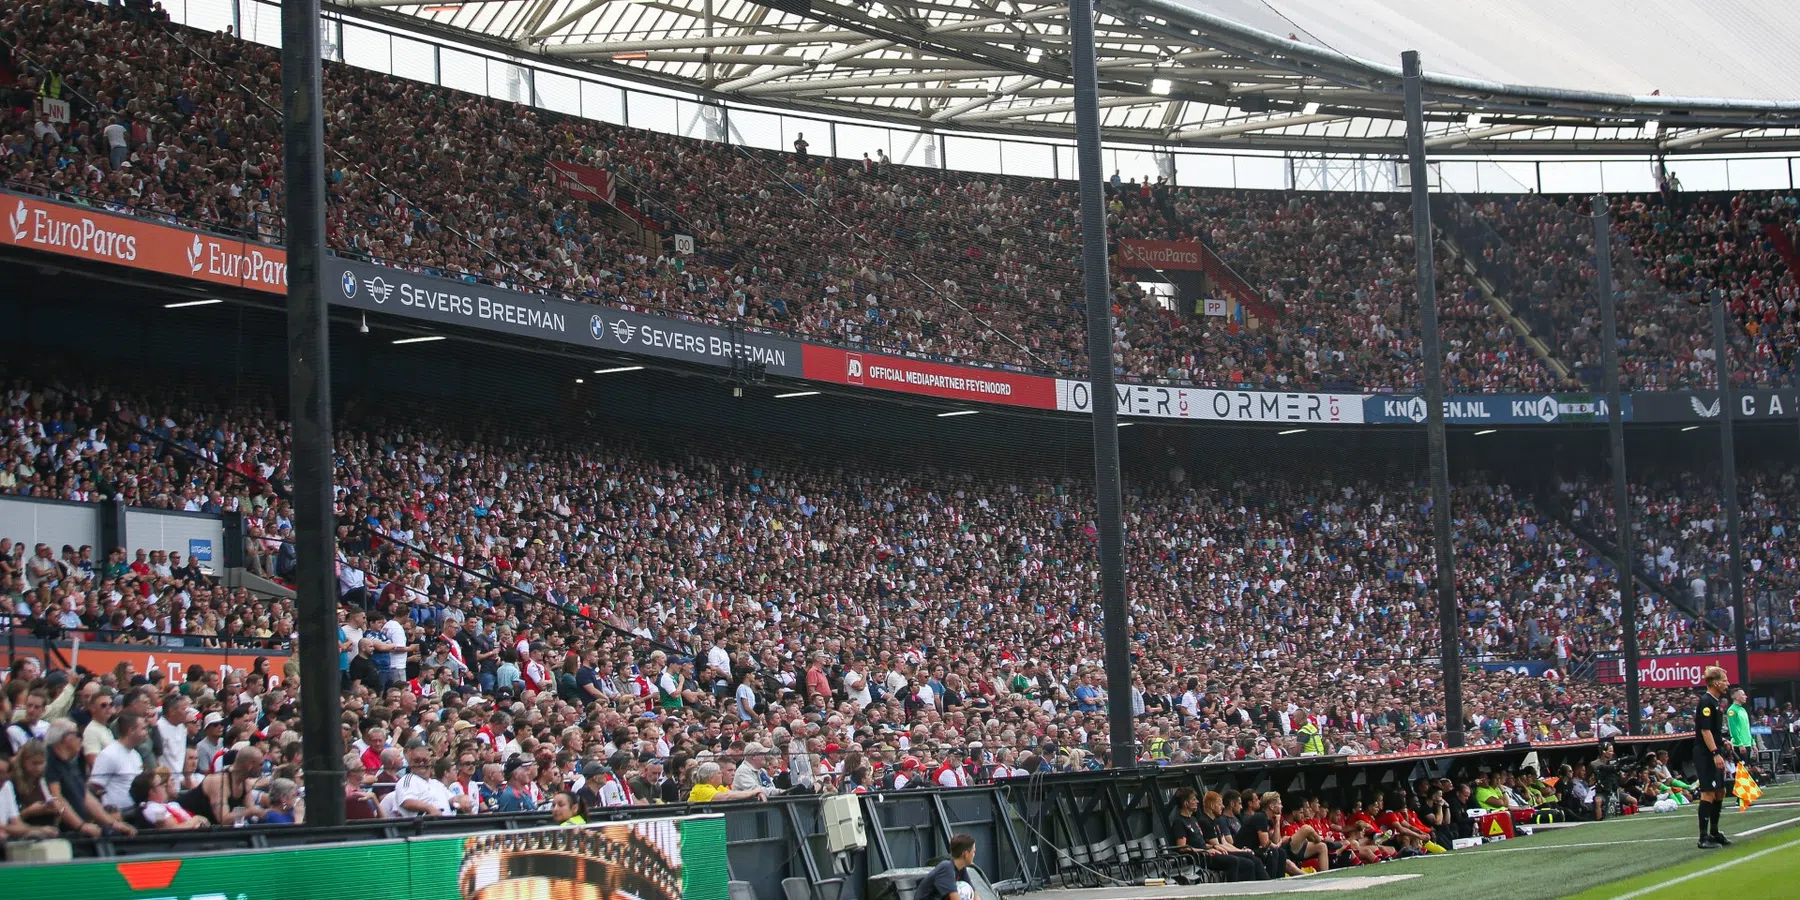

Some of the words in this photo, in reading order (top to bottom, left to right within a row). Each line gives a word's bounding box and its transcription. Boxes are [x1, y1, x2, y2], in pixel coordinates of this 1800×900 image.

[49, 104, 64, 119] NN
[33, 209, 137, 261] EuroParcs
[1137, 246, 1198, 264] EuroParcs
[400, 283, 473, 316] SEVERS
[478, 297, 565, 332] BREEMAN
[1208, 303, 1221, 312] PP
[641, 325, 706, 354] SEVERS
[709, 336, 786, 367] BREEMAN
[848, 359, 862, 378] AD
[869, 366, 905, 382] OFFICIAL
[906, 371, 965, 391] MEDIAPARTNER
[966, 379, 1011, 396] FEYENOORD
[1073, 383, 1171, 415] OMER
[1178, 390, 1188, 416] ICT
[1213, 391, 1322, 420] ORMER
[1329, 395, 1340, 421] ICT
[1384, 399, 1490, 419] KNAEN.NL
